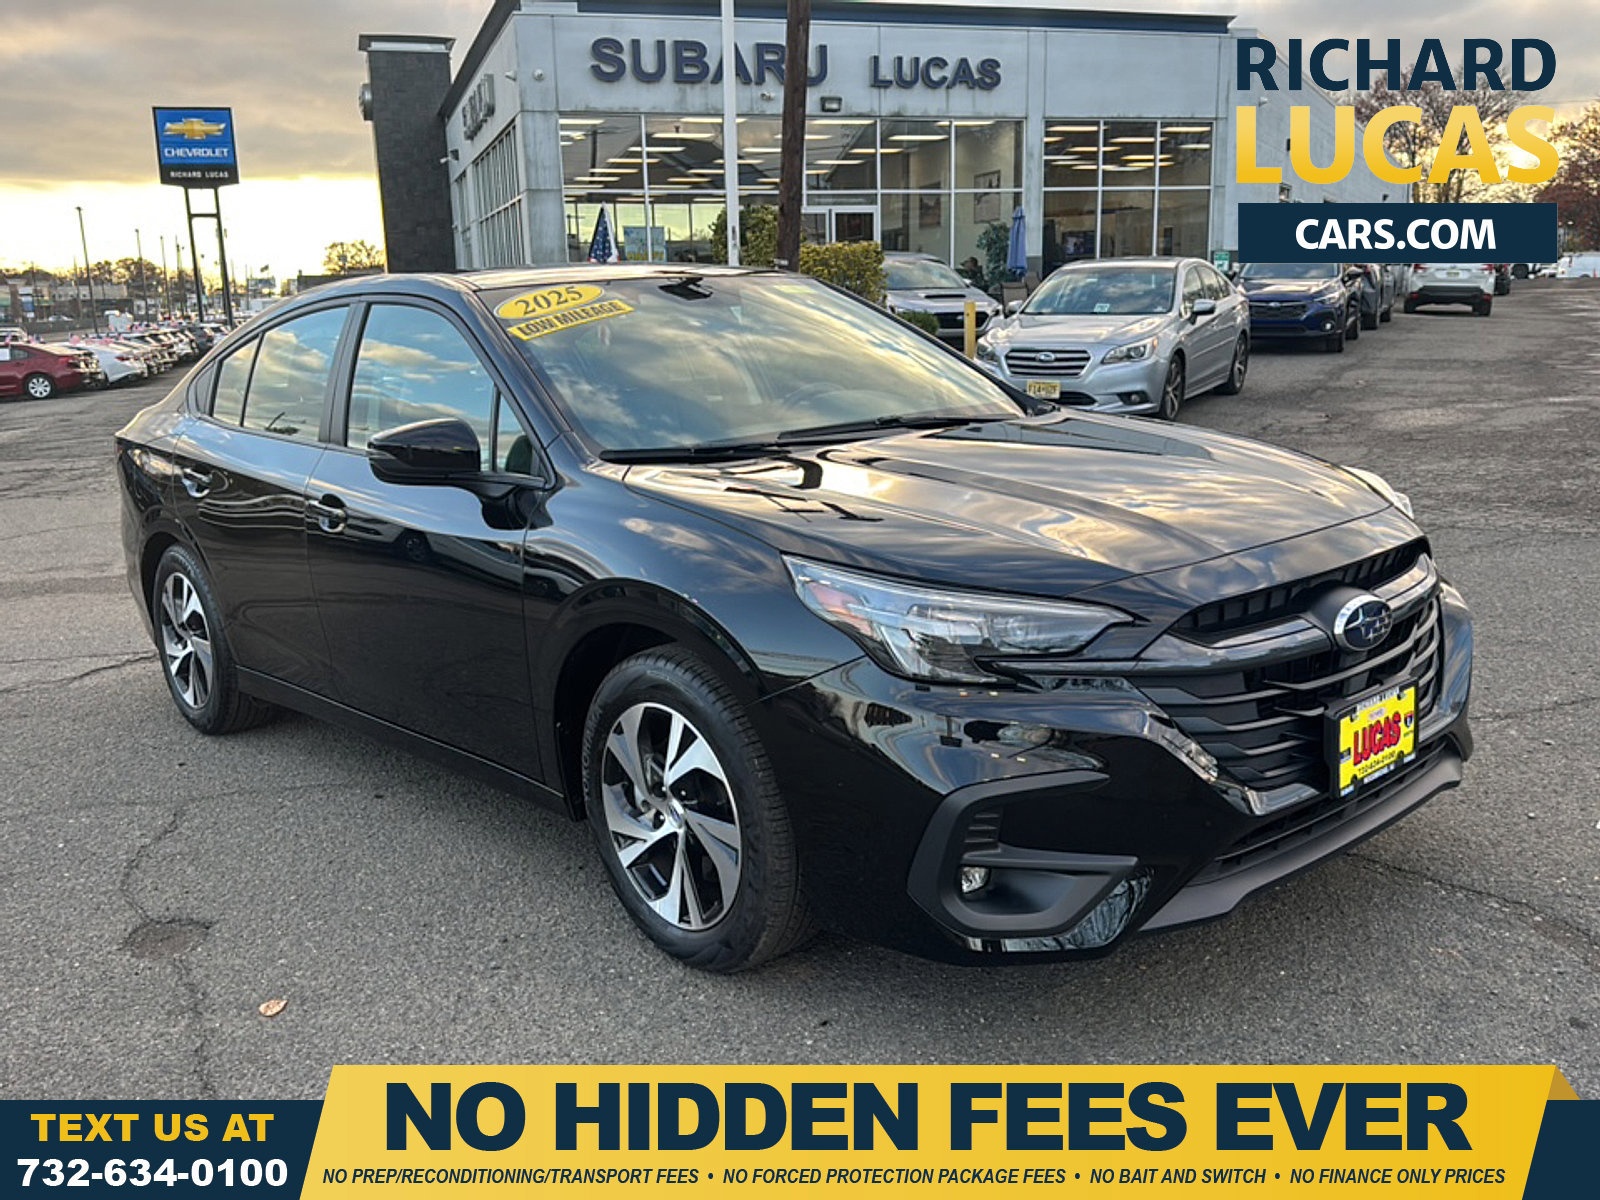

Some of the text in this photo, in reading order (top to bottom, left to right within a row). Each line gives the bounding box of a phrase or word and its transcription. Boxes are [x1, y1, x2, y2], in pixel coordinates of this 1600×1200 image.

[591, 37, 1001, 90] SUBARU LUCAS
[164, 147, 228, 157] CHEVROLET
[515, 286, 583, 316] 2025
[517, 301, 625, 336] LOW MILEAGE
[1353, 711, 1401, 766] LUCAS
